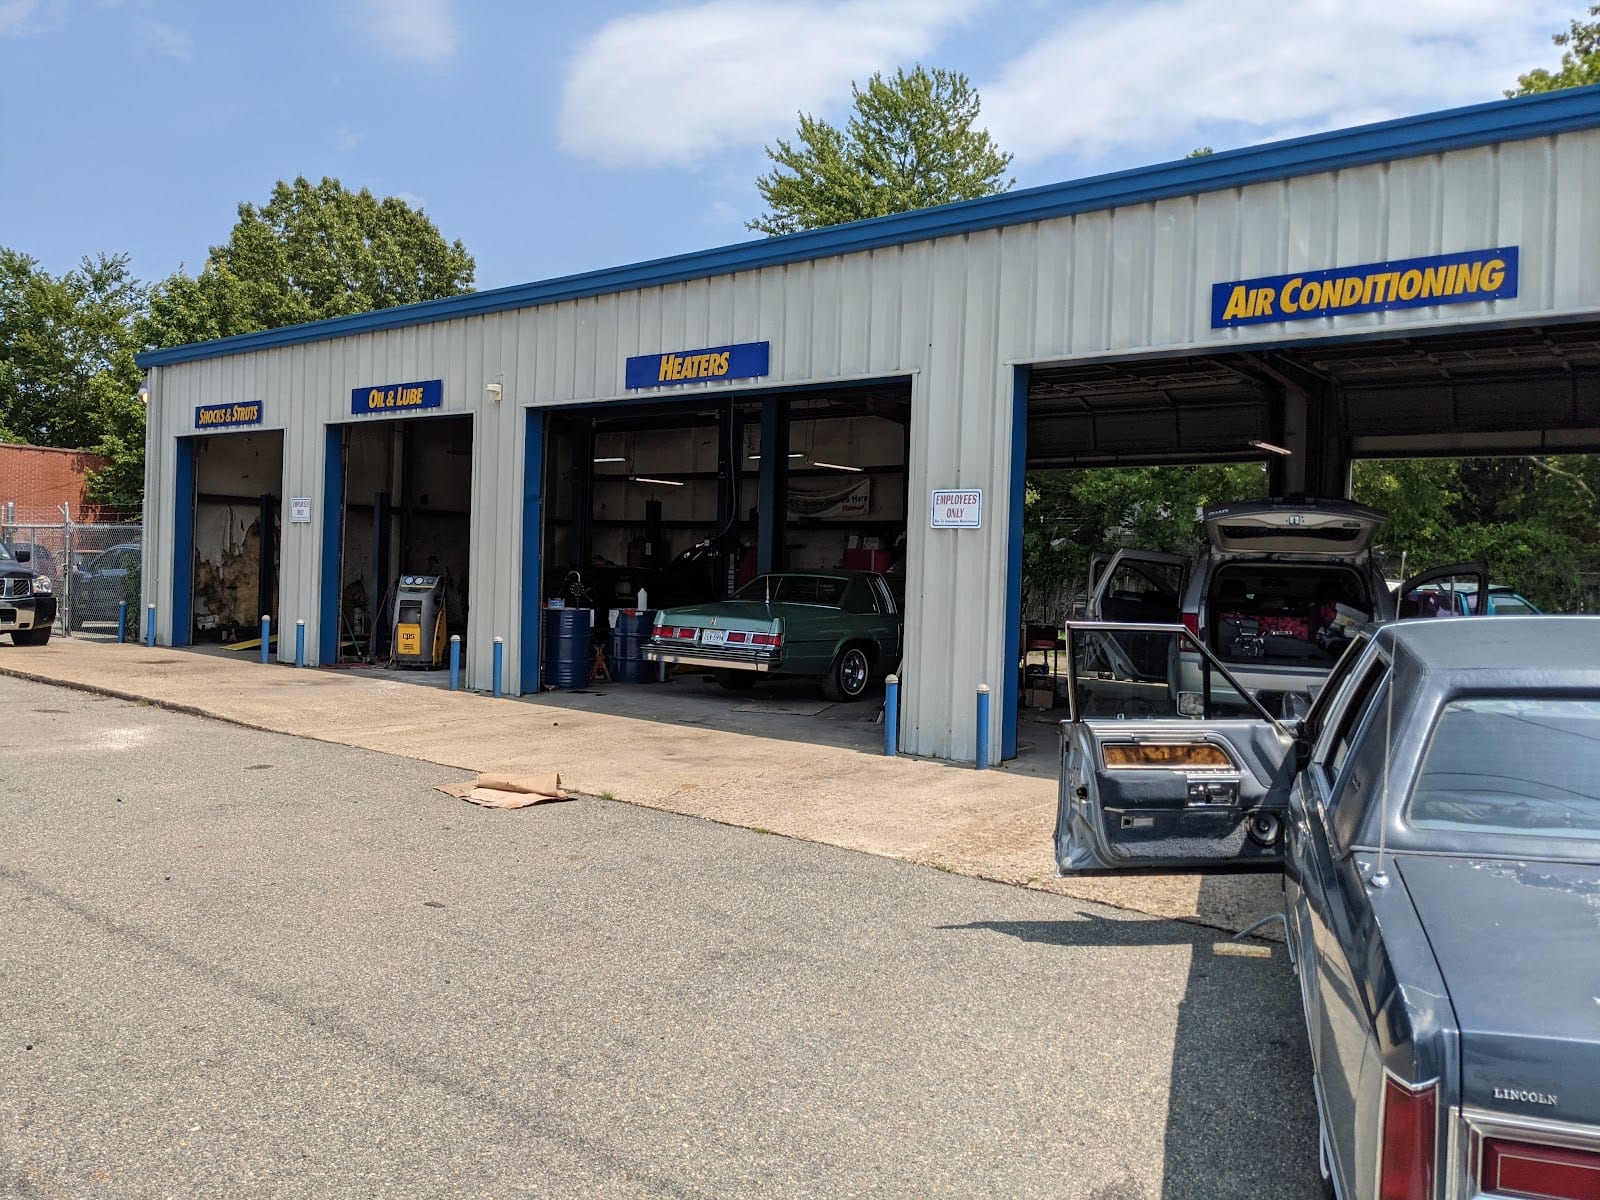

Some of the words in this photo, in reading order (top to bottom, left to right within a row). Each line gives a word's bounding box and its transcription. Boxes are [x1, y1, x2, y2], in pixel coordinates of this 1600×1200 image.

[1222, 285, 1276, 321] AIR
[1279, 258, 1506, 314] CONDITIONING
[658, 351, 730, 382] HEATERS
[368, 389, 386, 409] OIL
[386, 390, 395, 407] &
[396, 386, 424, 406] LUBE
[199, 408, 225, 425] SHOCKS
[225, 408, 232, 423] &
[232, 404, 258, 422] STRUTS
[935, 494, 978, 506] EMPLOYEES
[946, 507, 965, 519] ONLY
[1493, 1087, 1558, 1106] LINCOLN
